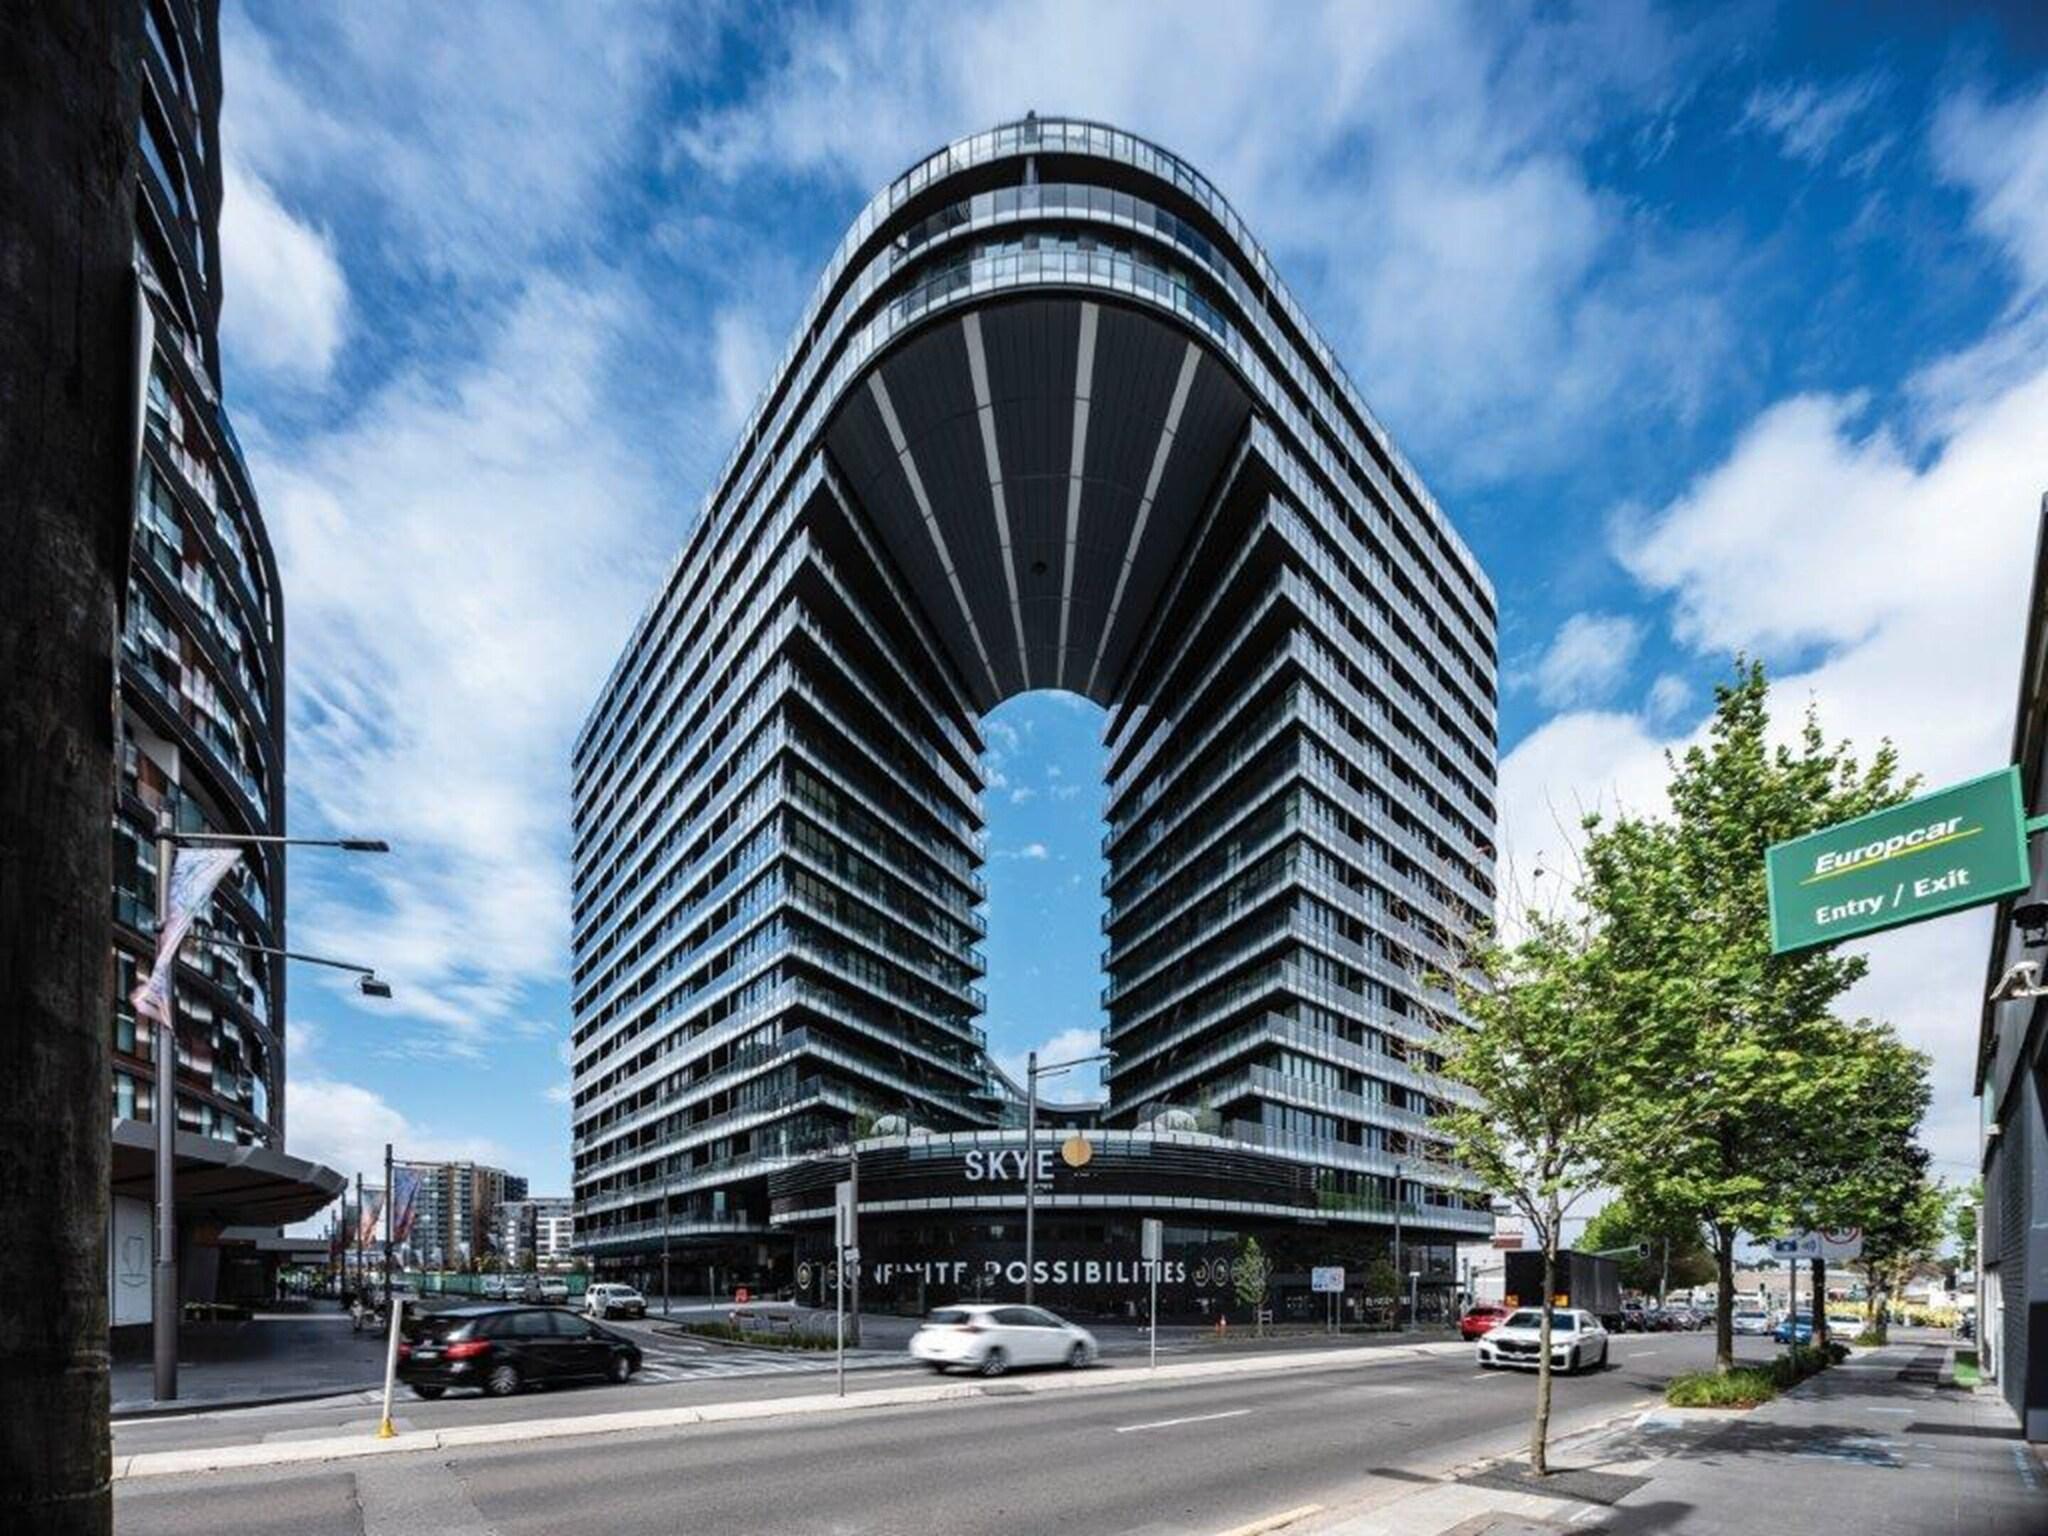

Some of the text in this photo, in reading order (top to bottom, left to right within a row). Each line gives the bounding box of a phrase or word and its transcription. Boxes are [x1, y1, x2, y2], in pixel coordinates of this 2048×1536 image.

[1814, 817, 1962, 874] Europcar
[1816, 894, 1884, 924] Entry
[1914, 867, 1971, 899] Exit
[964, 1149, 1055, 1181] SKYE
[984, 1261, 1187, 1285] POSSIBILITIES
